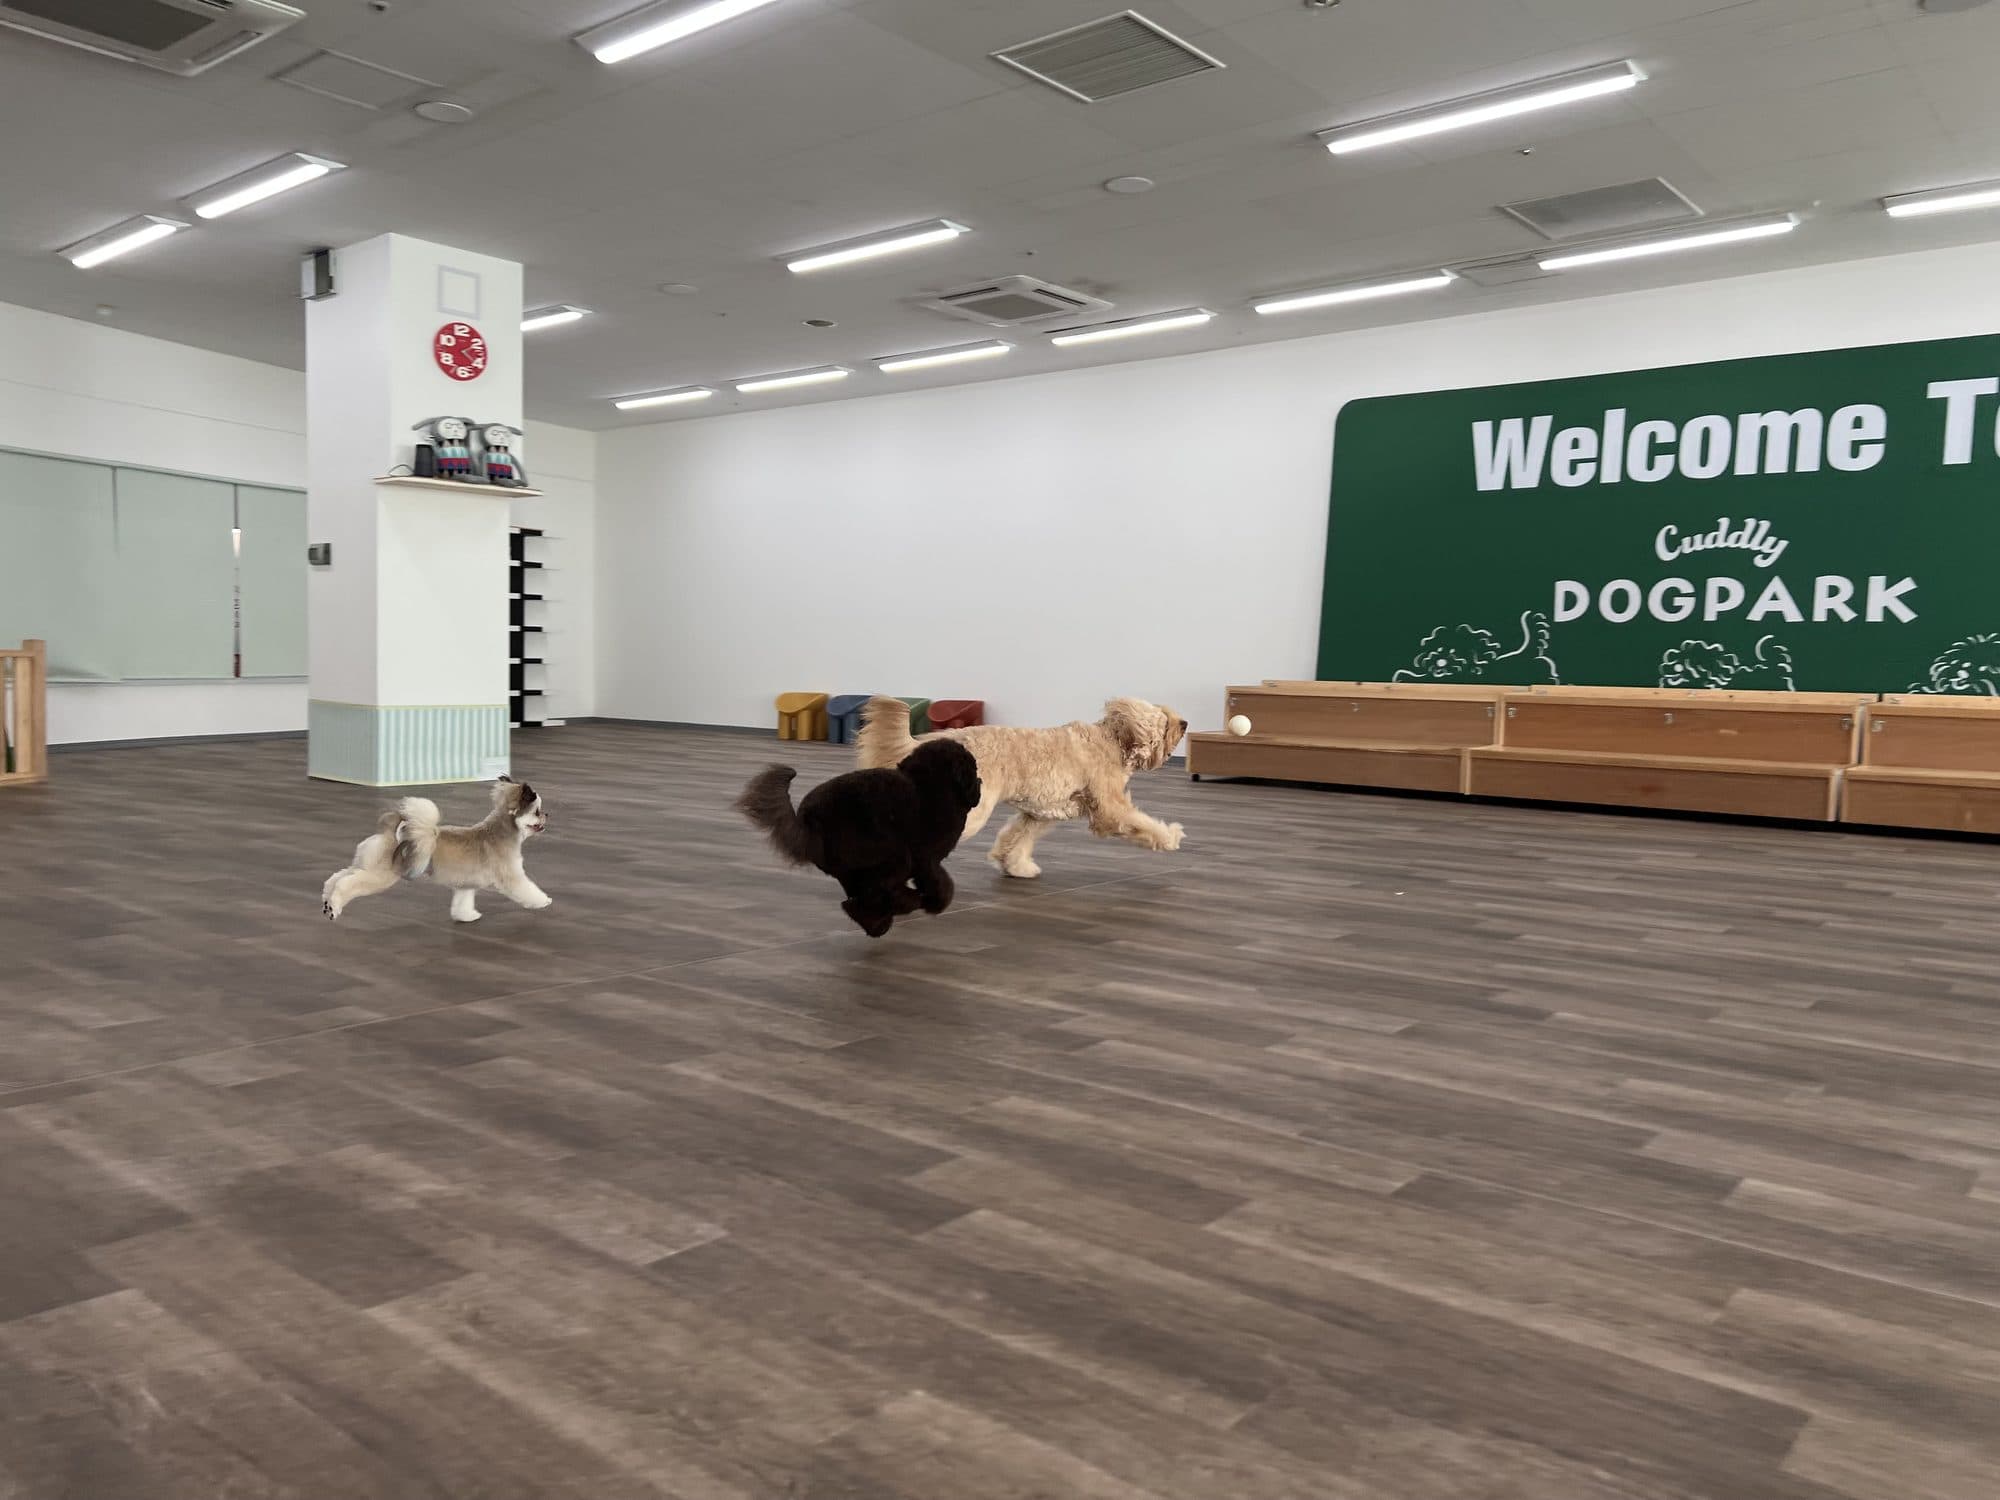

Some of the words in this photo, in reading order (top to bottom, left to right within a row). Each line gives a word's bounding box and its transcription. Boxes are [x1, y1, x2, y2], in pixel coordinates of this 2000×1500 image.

[454, 324, 470, 337] 12
[440, 333, 456, 346] 10
[470, 338, 483, 350] 2
[440, 352, 454, 364] 8
[471, 357, 484, 369] 4
[456, 366, 469, 378] 6
[1472, 403, 1887, 491] Welcome
[1926, 376, 2000, 465] T
[1655, 517, 1789, 568] Cuddly
[1554, 575, 1918, 623] DOGPARK
